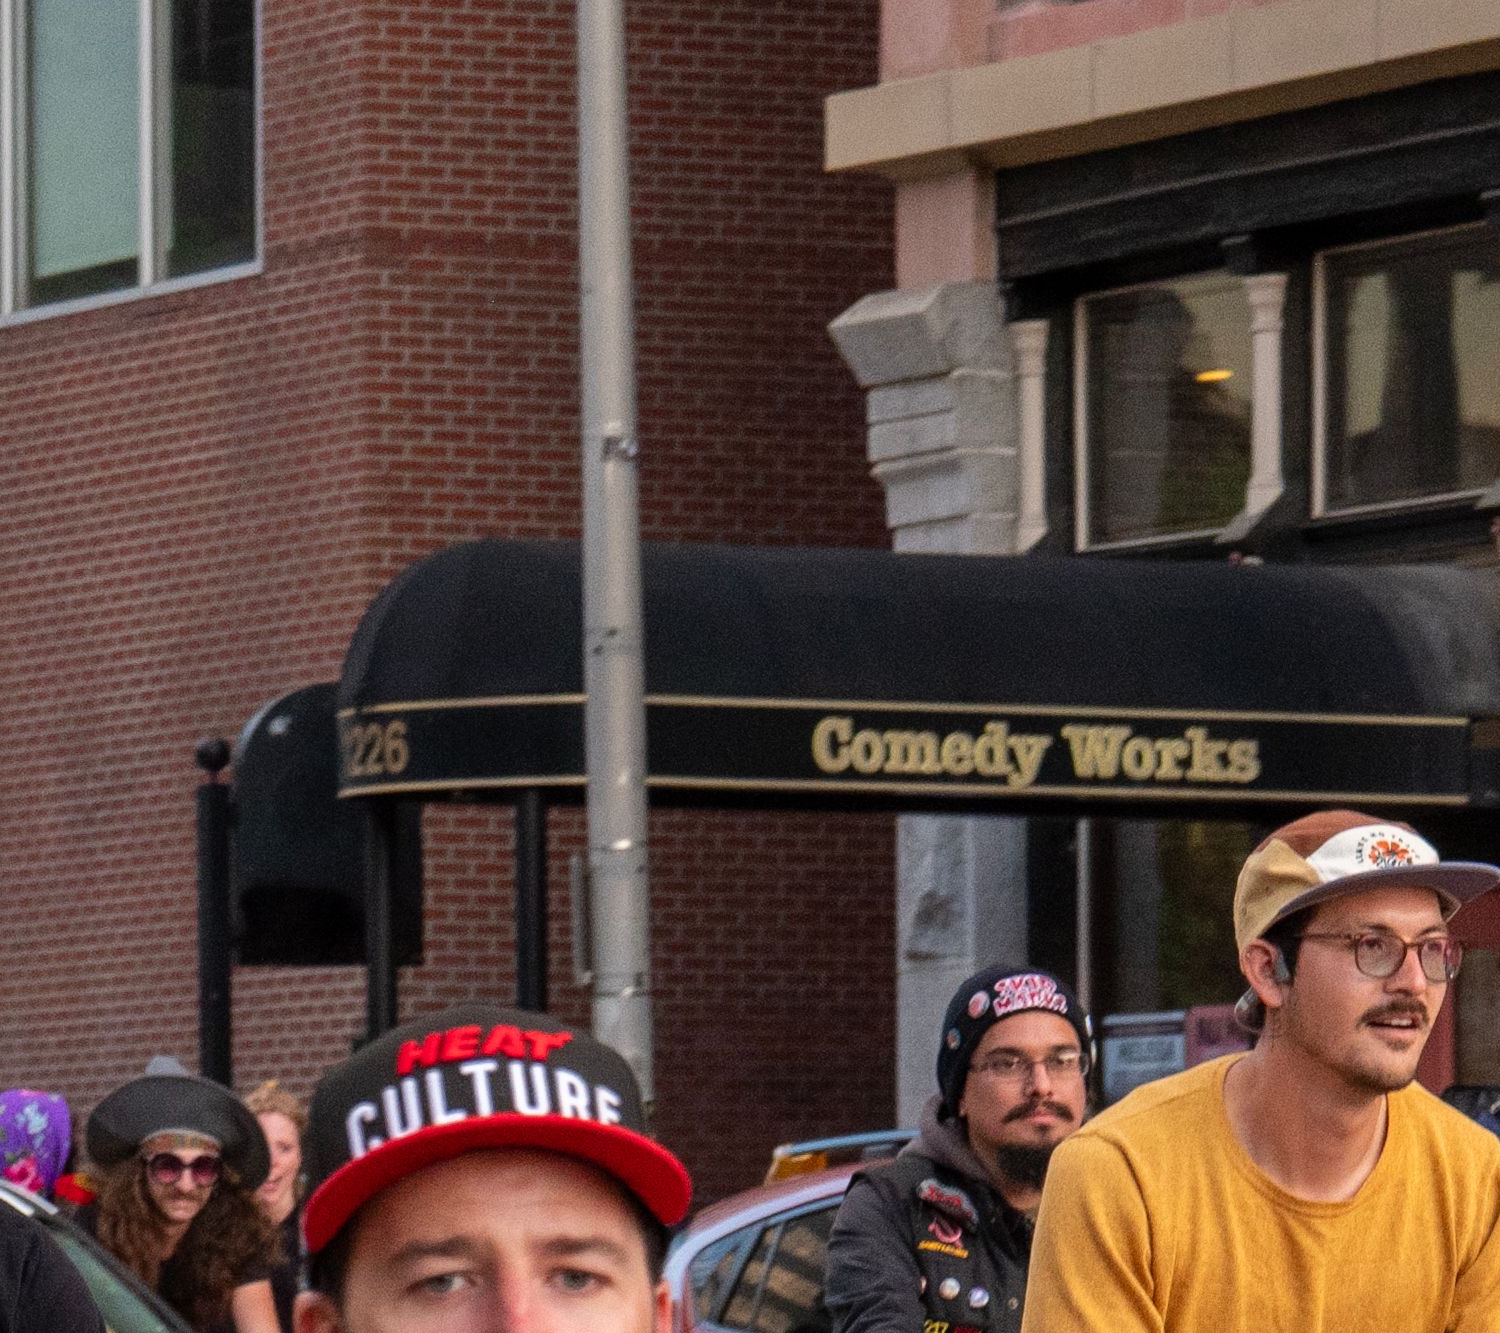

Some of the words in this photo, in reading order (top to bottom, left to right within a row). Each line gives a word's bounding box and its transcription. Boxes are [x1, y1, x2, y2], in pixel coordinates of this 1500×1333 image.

[811, 715, 1053, 789] Comedy
[1061, 723, 1262, 784] Works
[397, 1024, 574, 1076] HEAT
[345, 1058, 622, 1160] CULTURE
